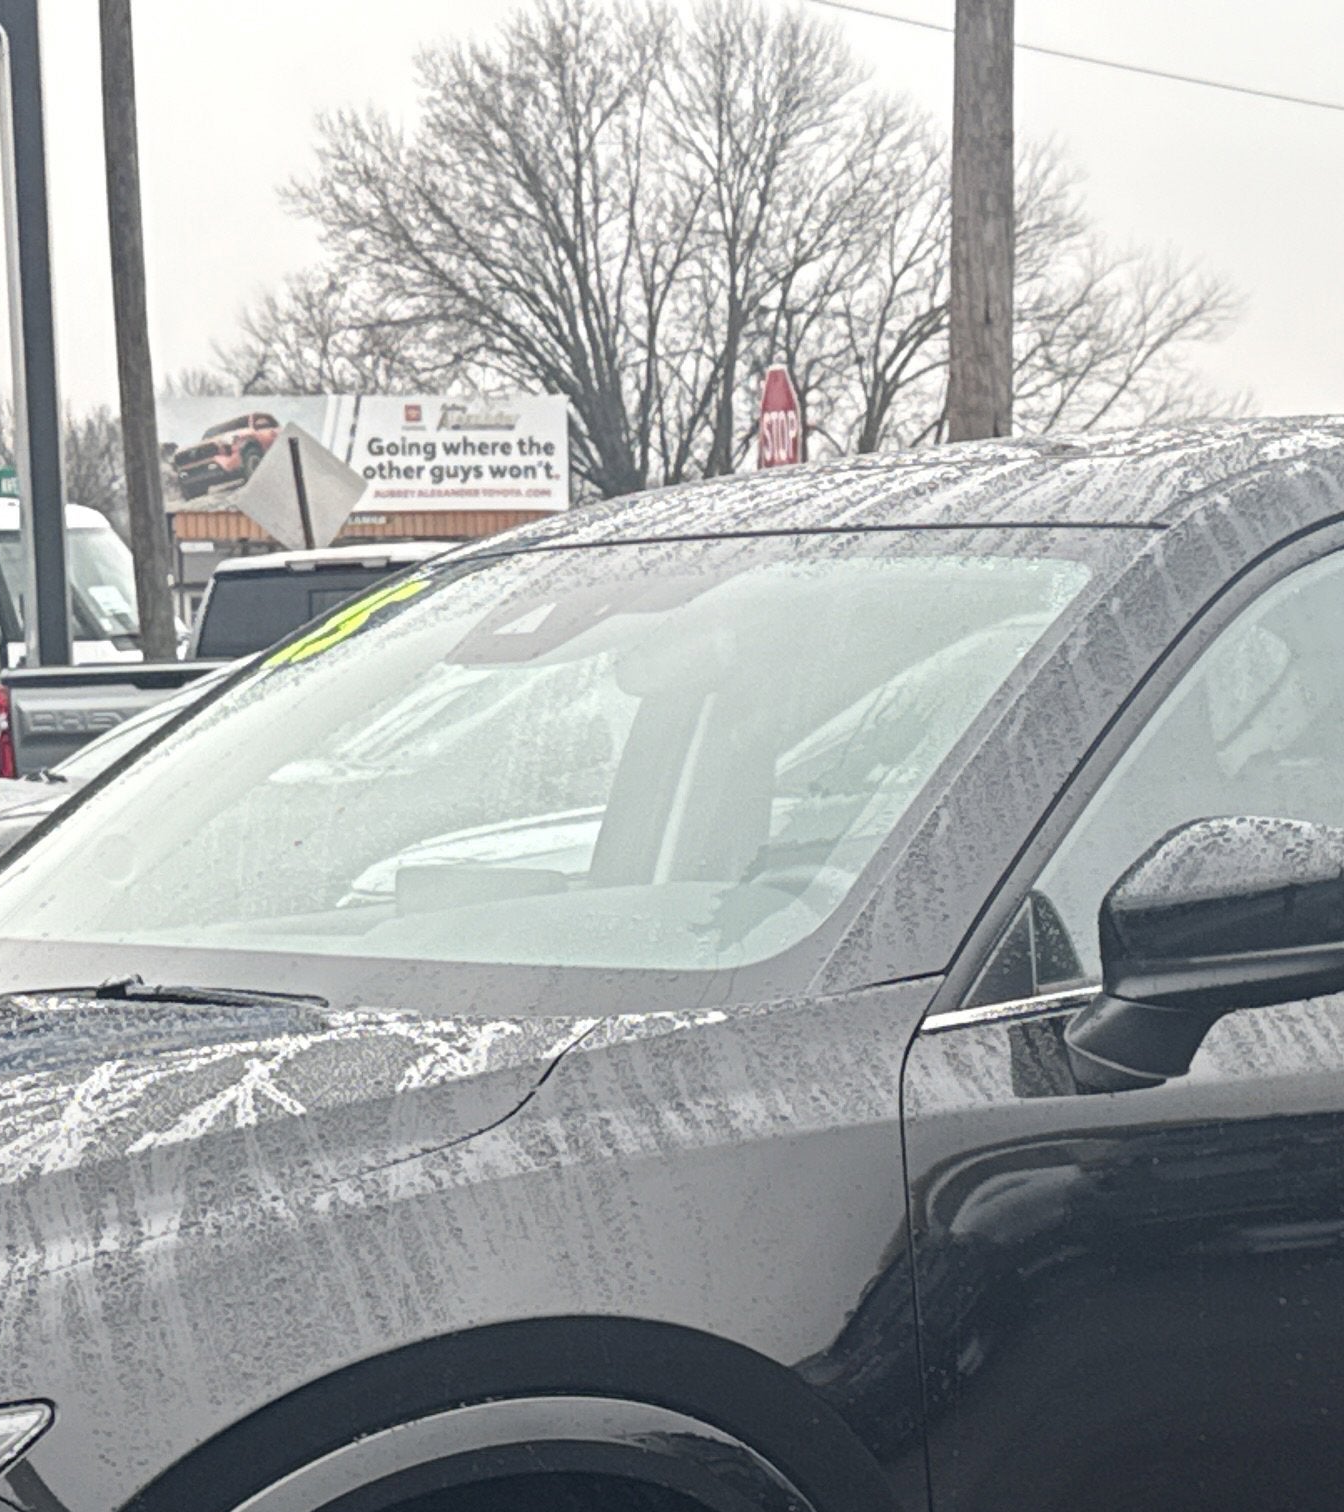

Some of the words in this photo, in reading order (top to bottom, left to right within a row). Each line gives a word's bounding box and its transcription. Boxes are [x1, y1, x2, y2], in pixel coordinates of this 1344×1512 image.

[762, 410, 797, 461] STOP
[367, 436, 437, 461] Going
[442, 436, 513, 456] where
[517, 436, 556, 456] the
[363, 461, 425, 480] other
[430, 464, 484, 484] guys
[488, 461, 561, 481] won't.
